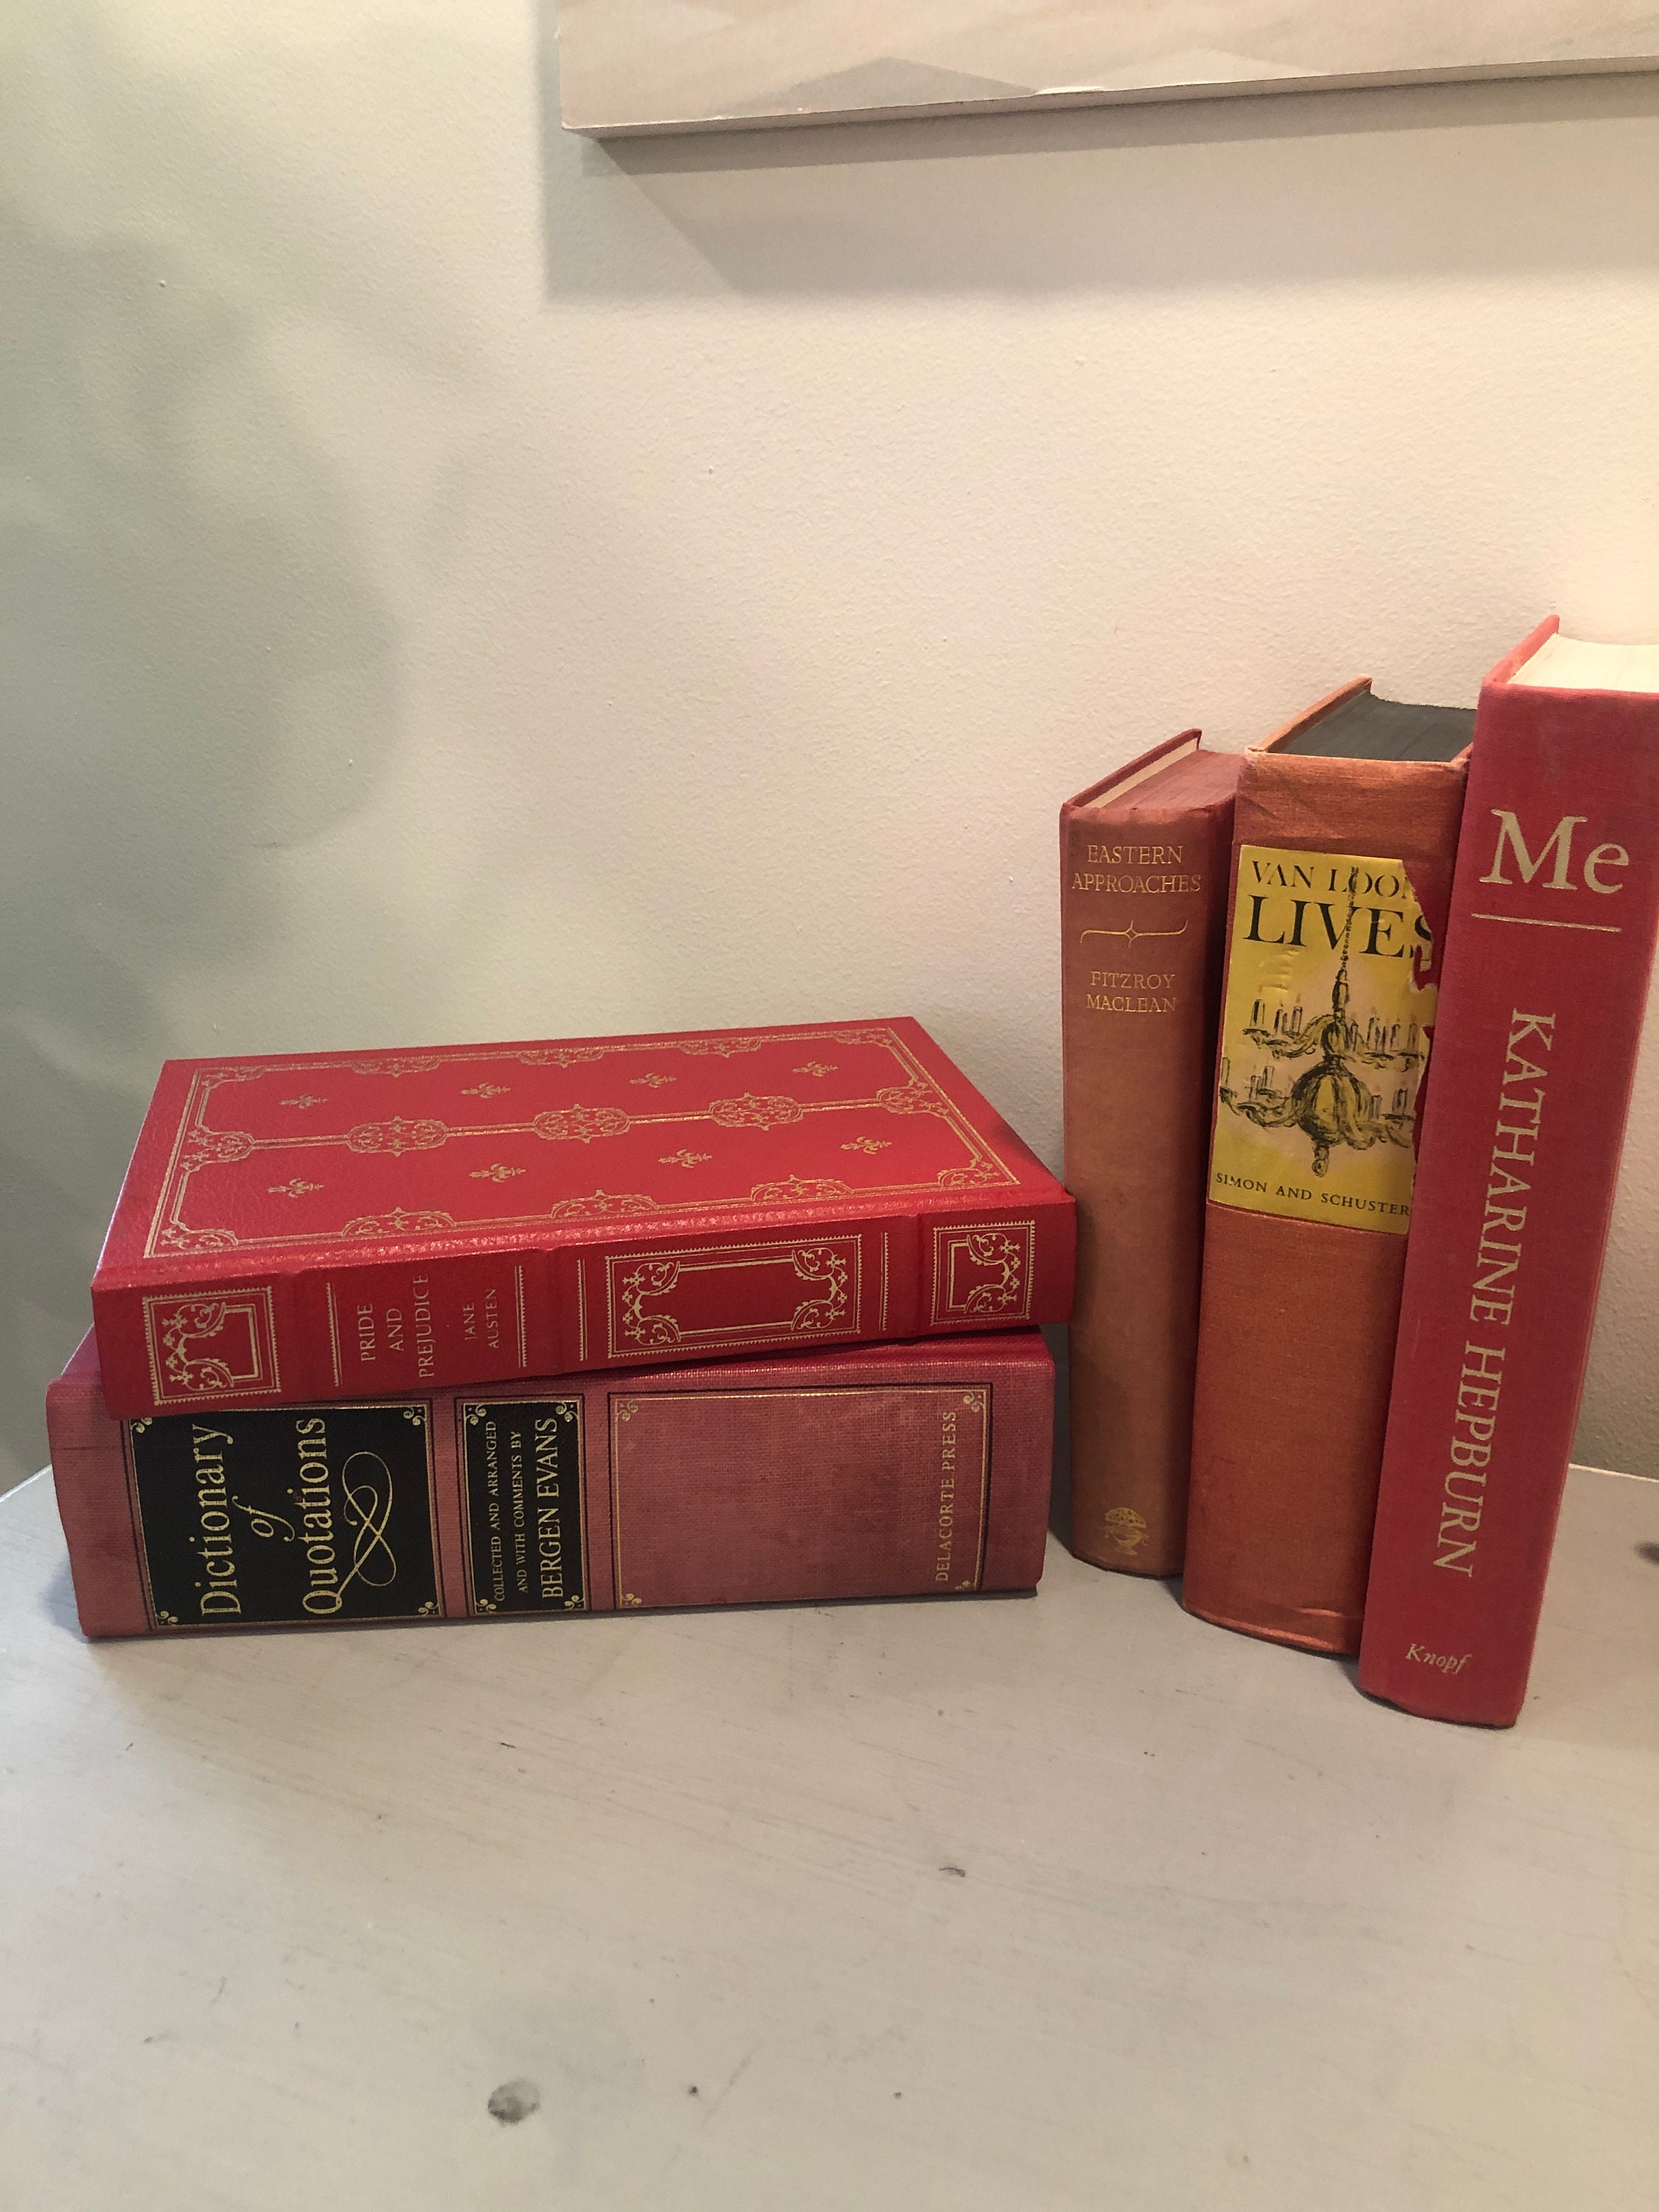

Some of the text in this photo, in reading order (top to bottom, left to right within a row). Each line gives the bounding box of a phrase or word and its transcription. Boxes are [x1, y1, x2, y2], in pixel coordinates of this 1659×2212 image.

[1086, 844, 1183, 865] EASTERN
[1251, 860, 1410, 901] VAN LOO
[1478, 808, 1630, 894] Me
[1071, 872, 1202, 894] APPROACHES
[1085, 993, 1177, 1013] MACLEAN
[1090, 970, 1176, 990] FITZROY
[1216, 1172, 1410, 1217] SIMON AND SCHUSTER
[462, 1301, 478, 1341] JANE
[484, 1288, 499, 1349] AUSTEN
[1433, 1007, 1557, 1578] KATHARINE HEPBURN
[357, 1303, 375, 1362] PRIDE
[386, 1308, 404, 1352] AND
[413, 1273, 436, 1378] PREJUDICE
[189, 1423, 242, 1616] Dictionary
[232, 1495, 296, 1543] of
[287, 1417, 343, 1615] Quotations
[485, 1420, 505, 1601] COLLECTED AND ARRANGED
[510, 1430, 529, 1593] AND WITH COMMENTS BY
[535, 1416, 563, 1599] BERGEN EVANS
[935, 1411, 956, 1582] DELACORTE PRESS
[1404, 1643, 1473, 1674] Knopf
